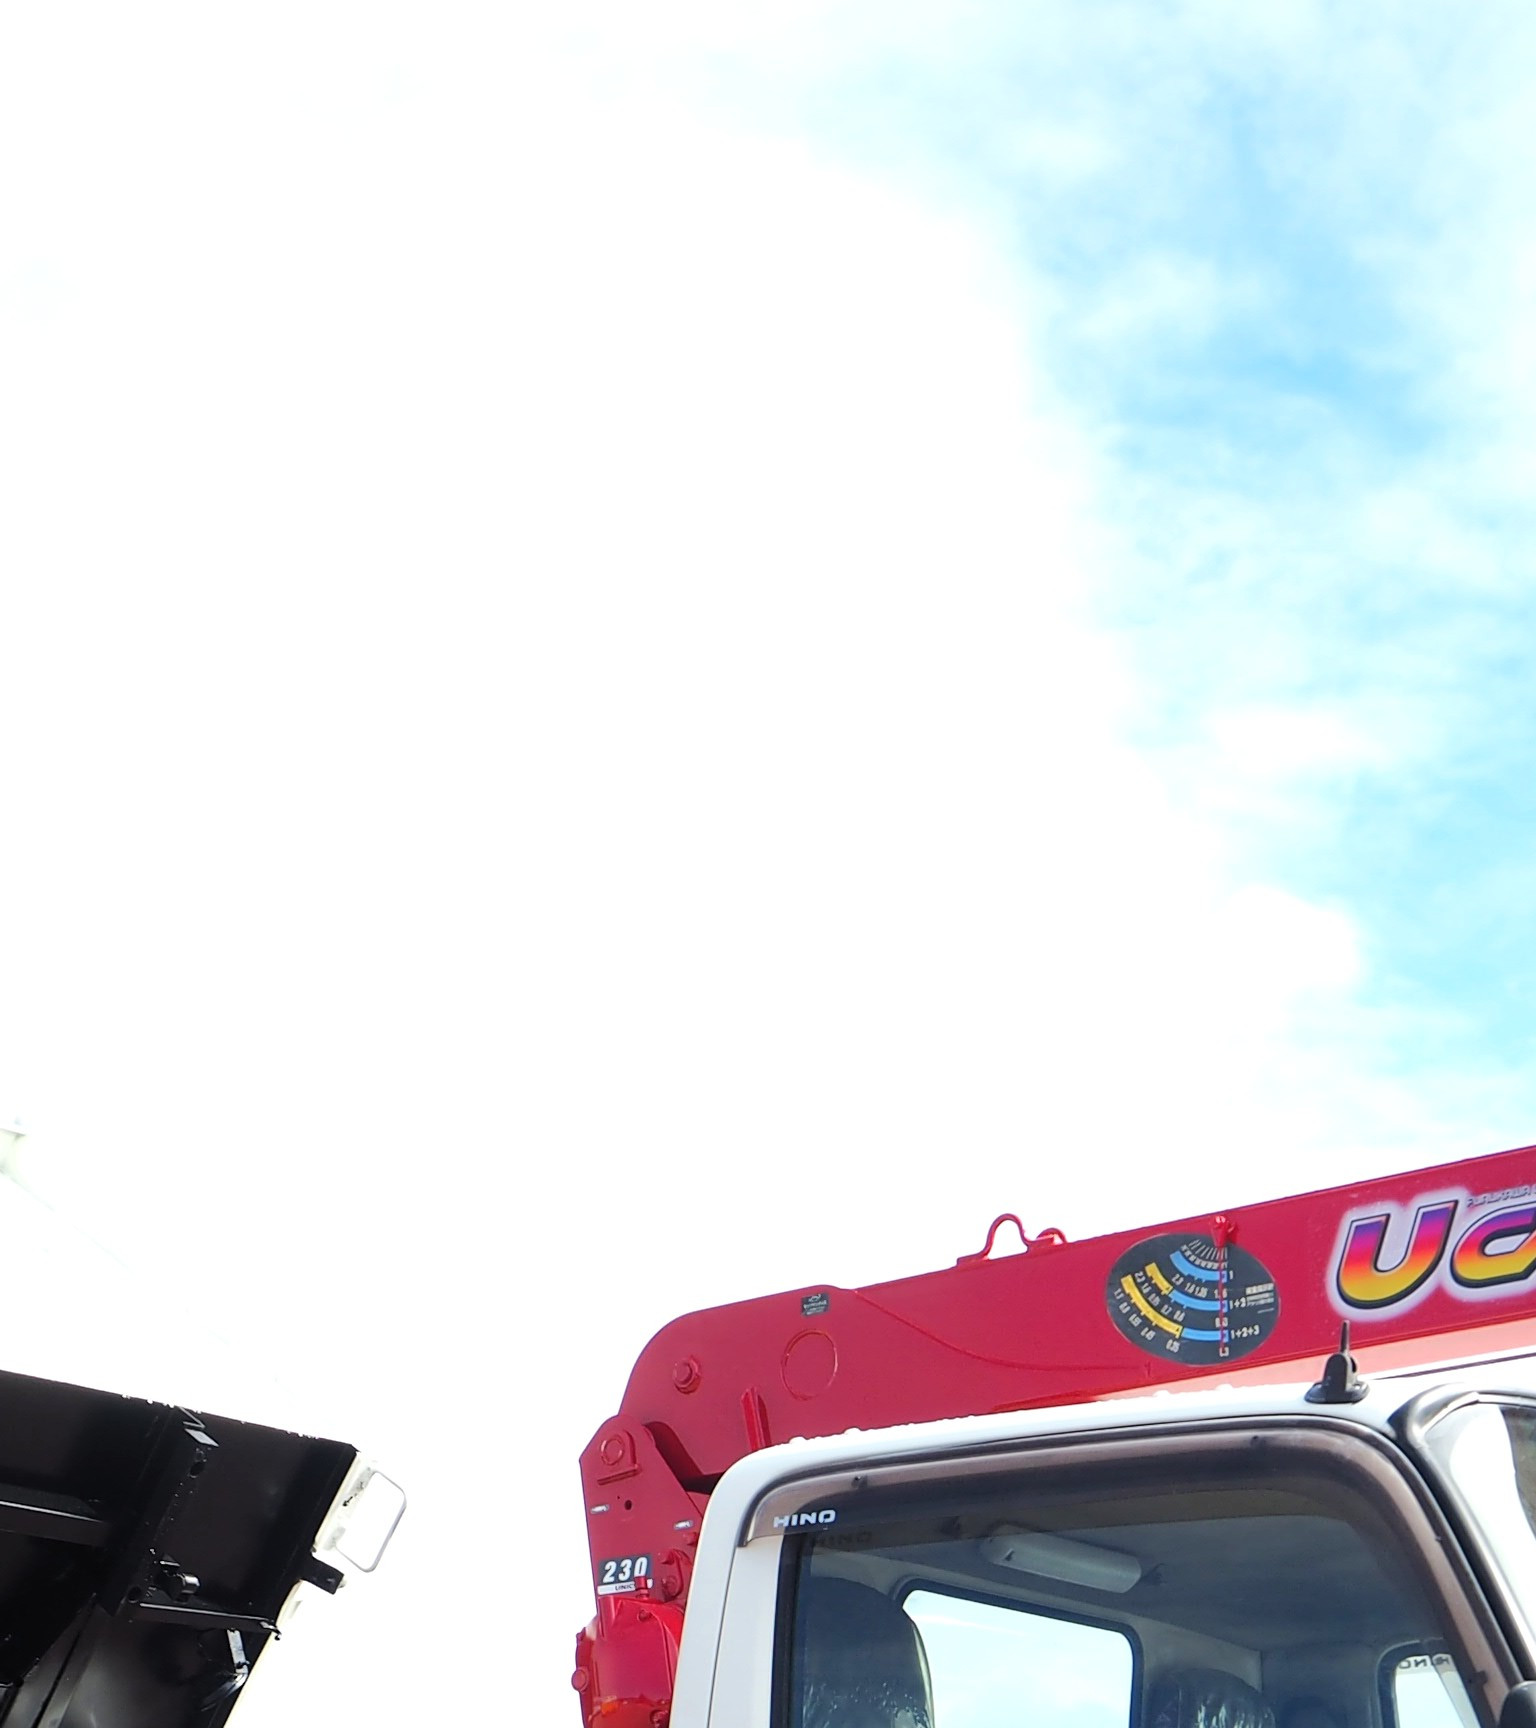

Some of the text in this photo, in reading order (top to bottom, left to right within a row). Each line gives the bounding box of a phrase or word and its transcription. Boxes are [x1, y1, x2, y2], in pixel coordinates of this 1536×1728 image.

[1230, 1324, 1260, 1340] 1+2+3
[773, 1509, 836, 1528] HINO
[602, 1556, 648, 1583] 230
